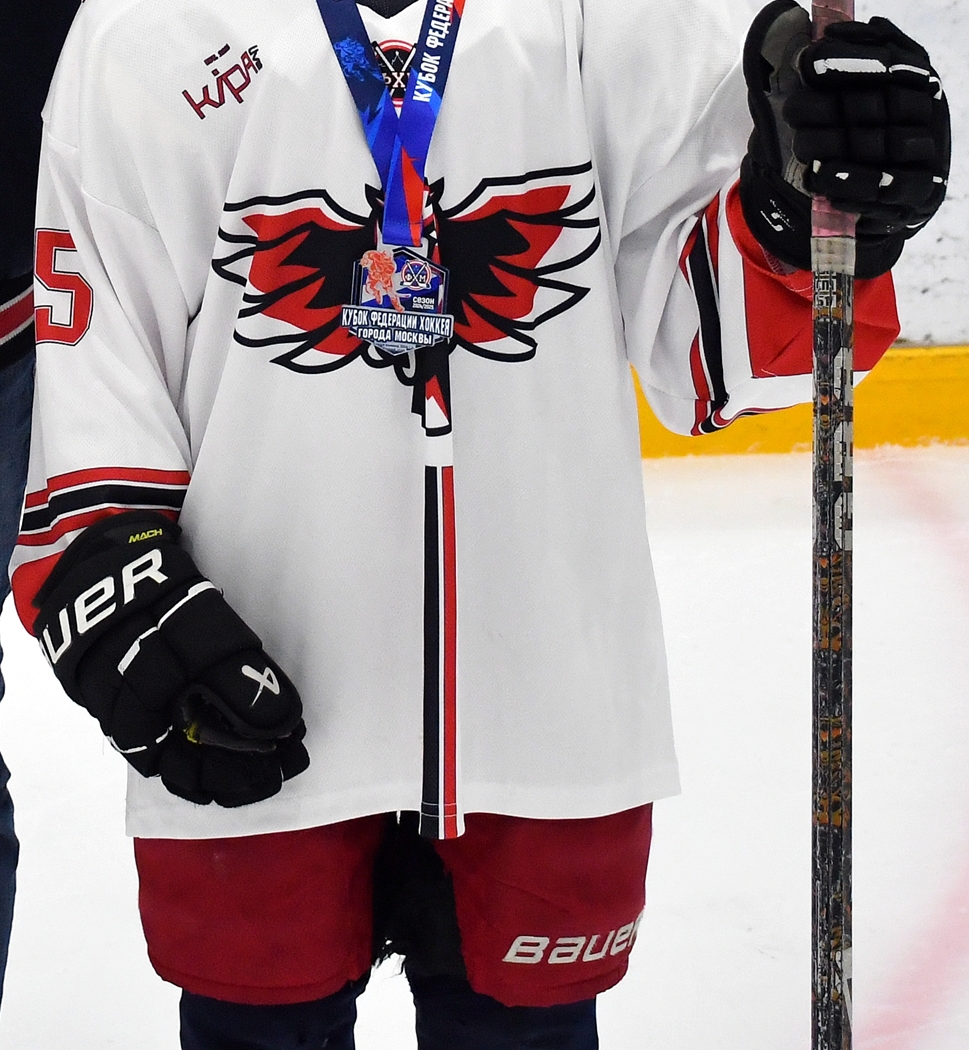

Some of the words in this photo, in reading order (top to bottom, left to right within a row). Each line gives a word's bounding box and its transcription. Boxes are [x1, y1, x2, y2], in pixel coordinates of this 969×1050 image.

[413, 52, 442, 102] КУБОК
[341, 308, 369, 326] КУБОК
[371, 311, 418, 329] ФЕДЕРАЦИИ
[419, 316, 451, 337] ХОККЕЯ
[358, 328, 392, 342] ГОРОДА
[394, 330, 432, 345] МОСКВЫ
[128, 528, 163, 544] MACH
